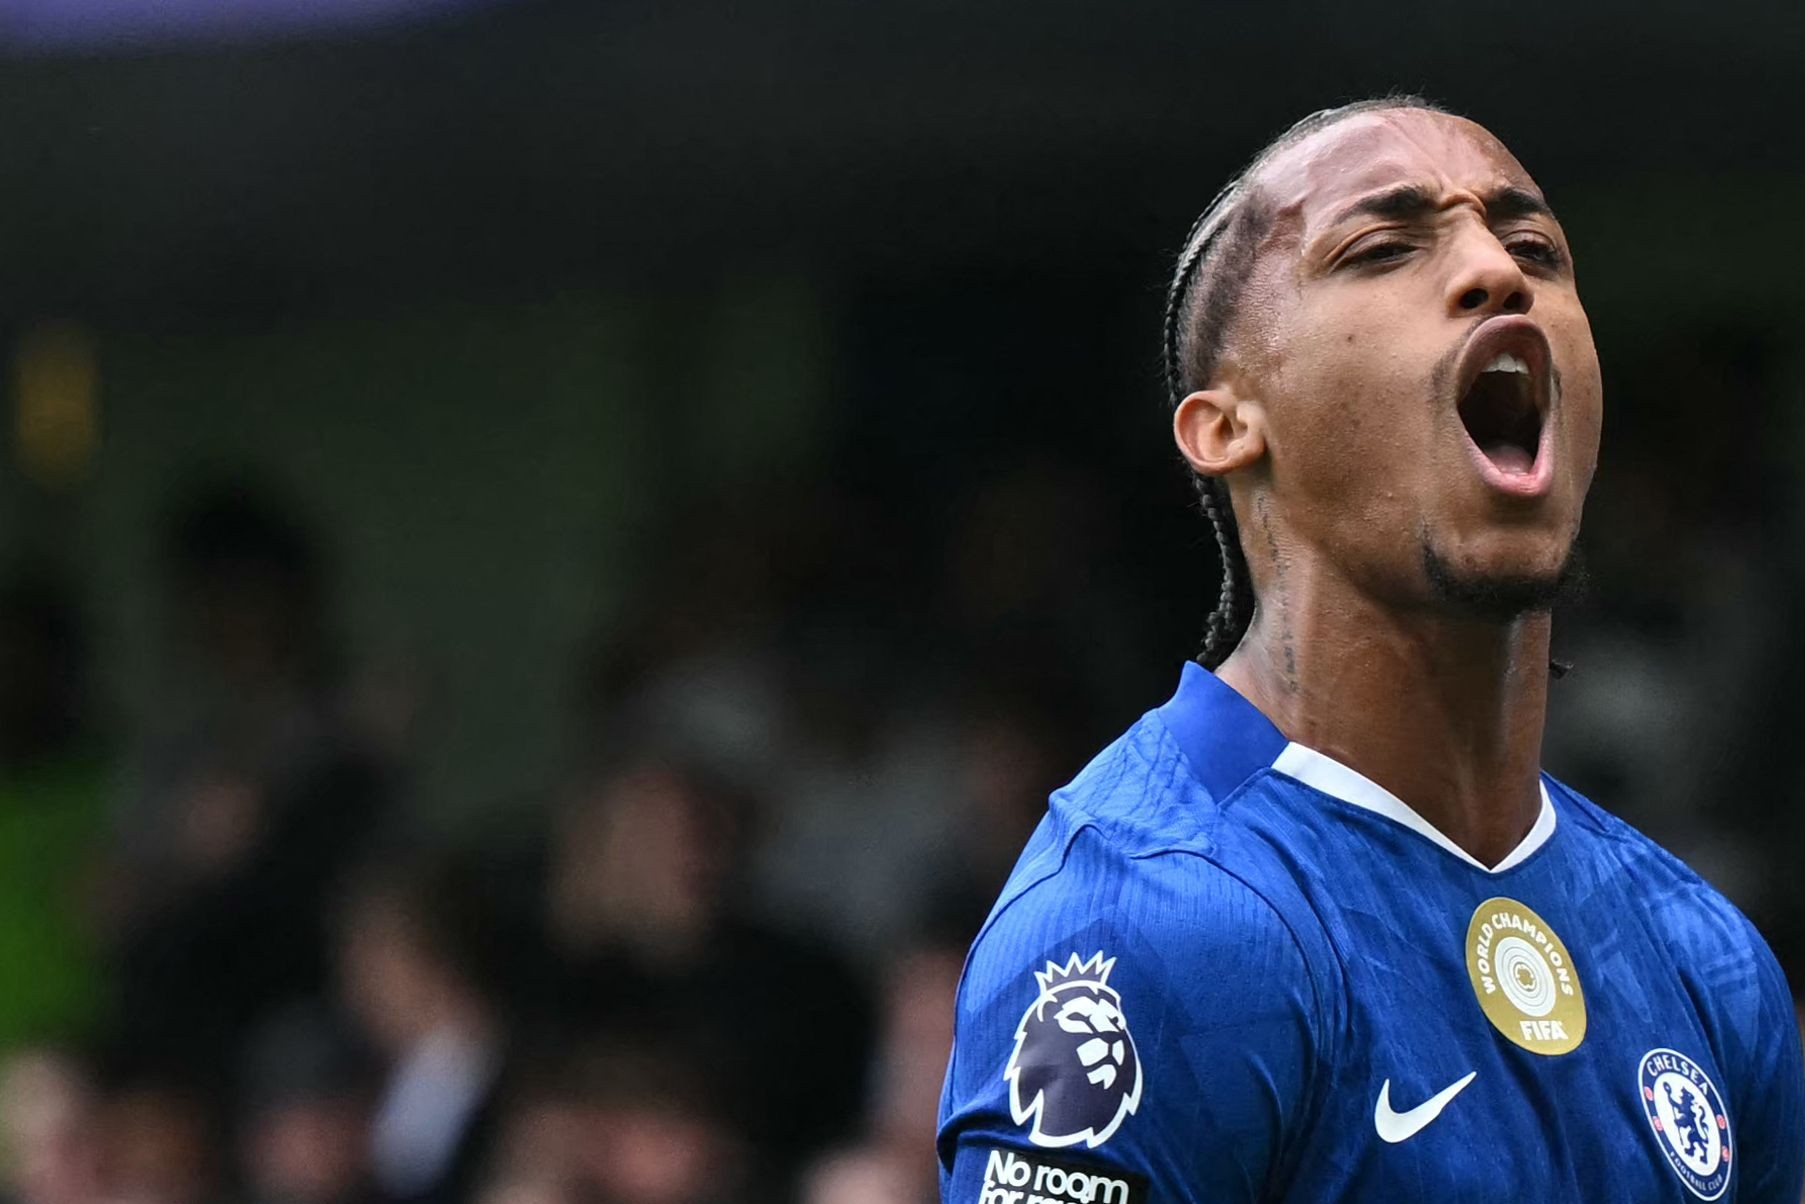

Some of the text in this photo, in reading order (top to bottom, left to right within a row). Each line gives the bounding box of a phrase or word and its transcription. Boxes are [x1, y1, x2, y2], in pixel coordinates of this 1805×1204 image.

[1477, 912, 1574, 996] WORLD CHAMPIONS
[1519, 1020, 1569, 1041] FIFA
[1646, 1055, 1708, 1096] CHELSEA
[984, 1150, 1031, 1187] No
